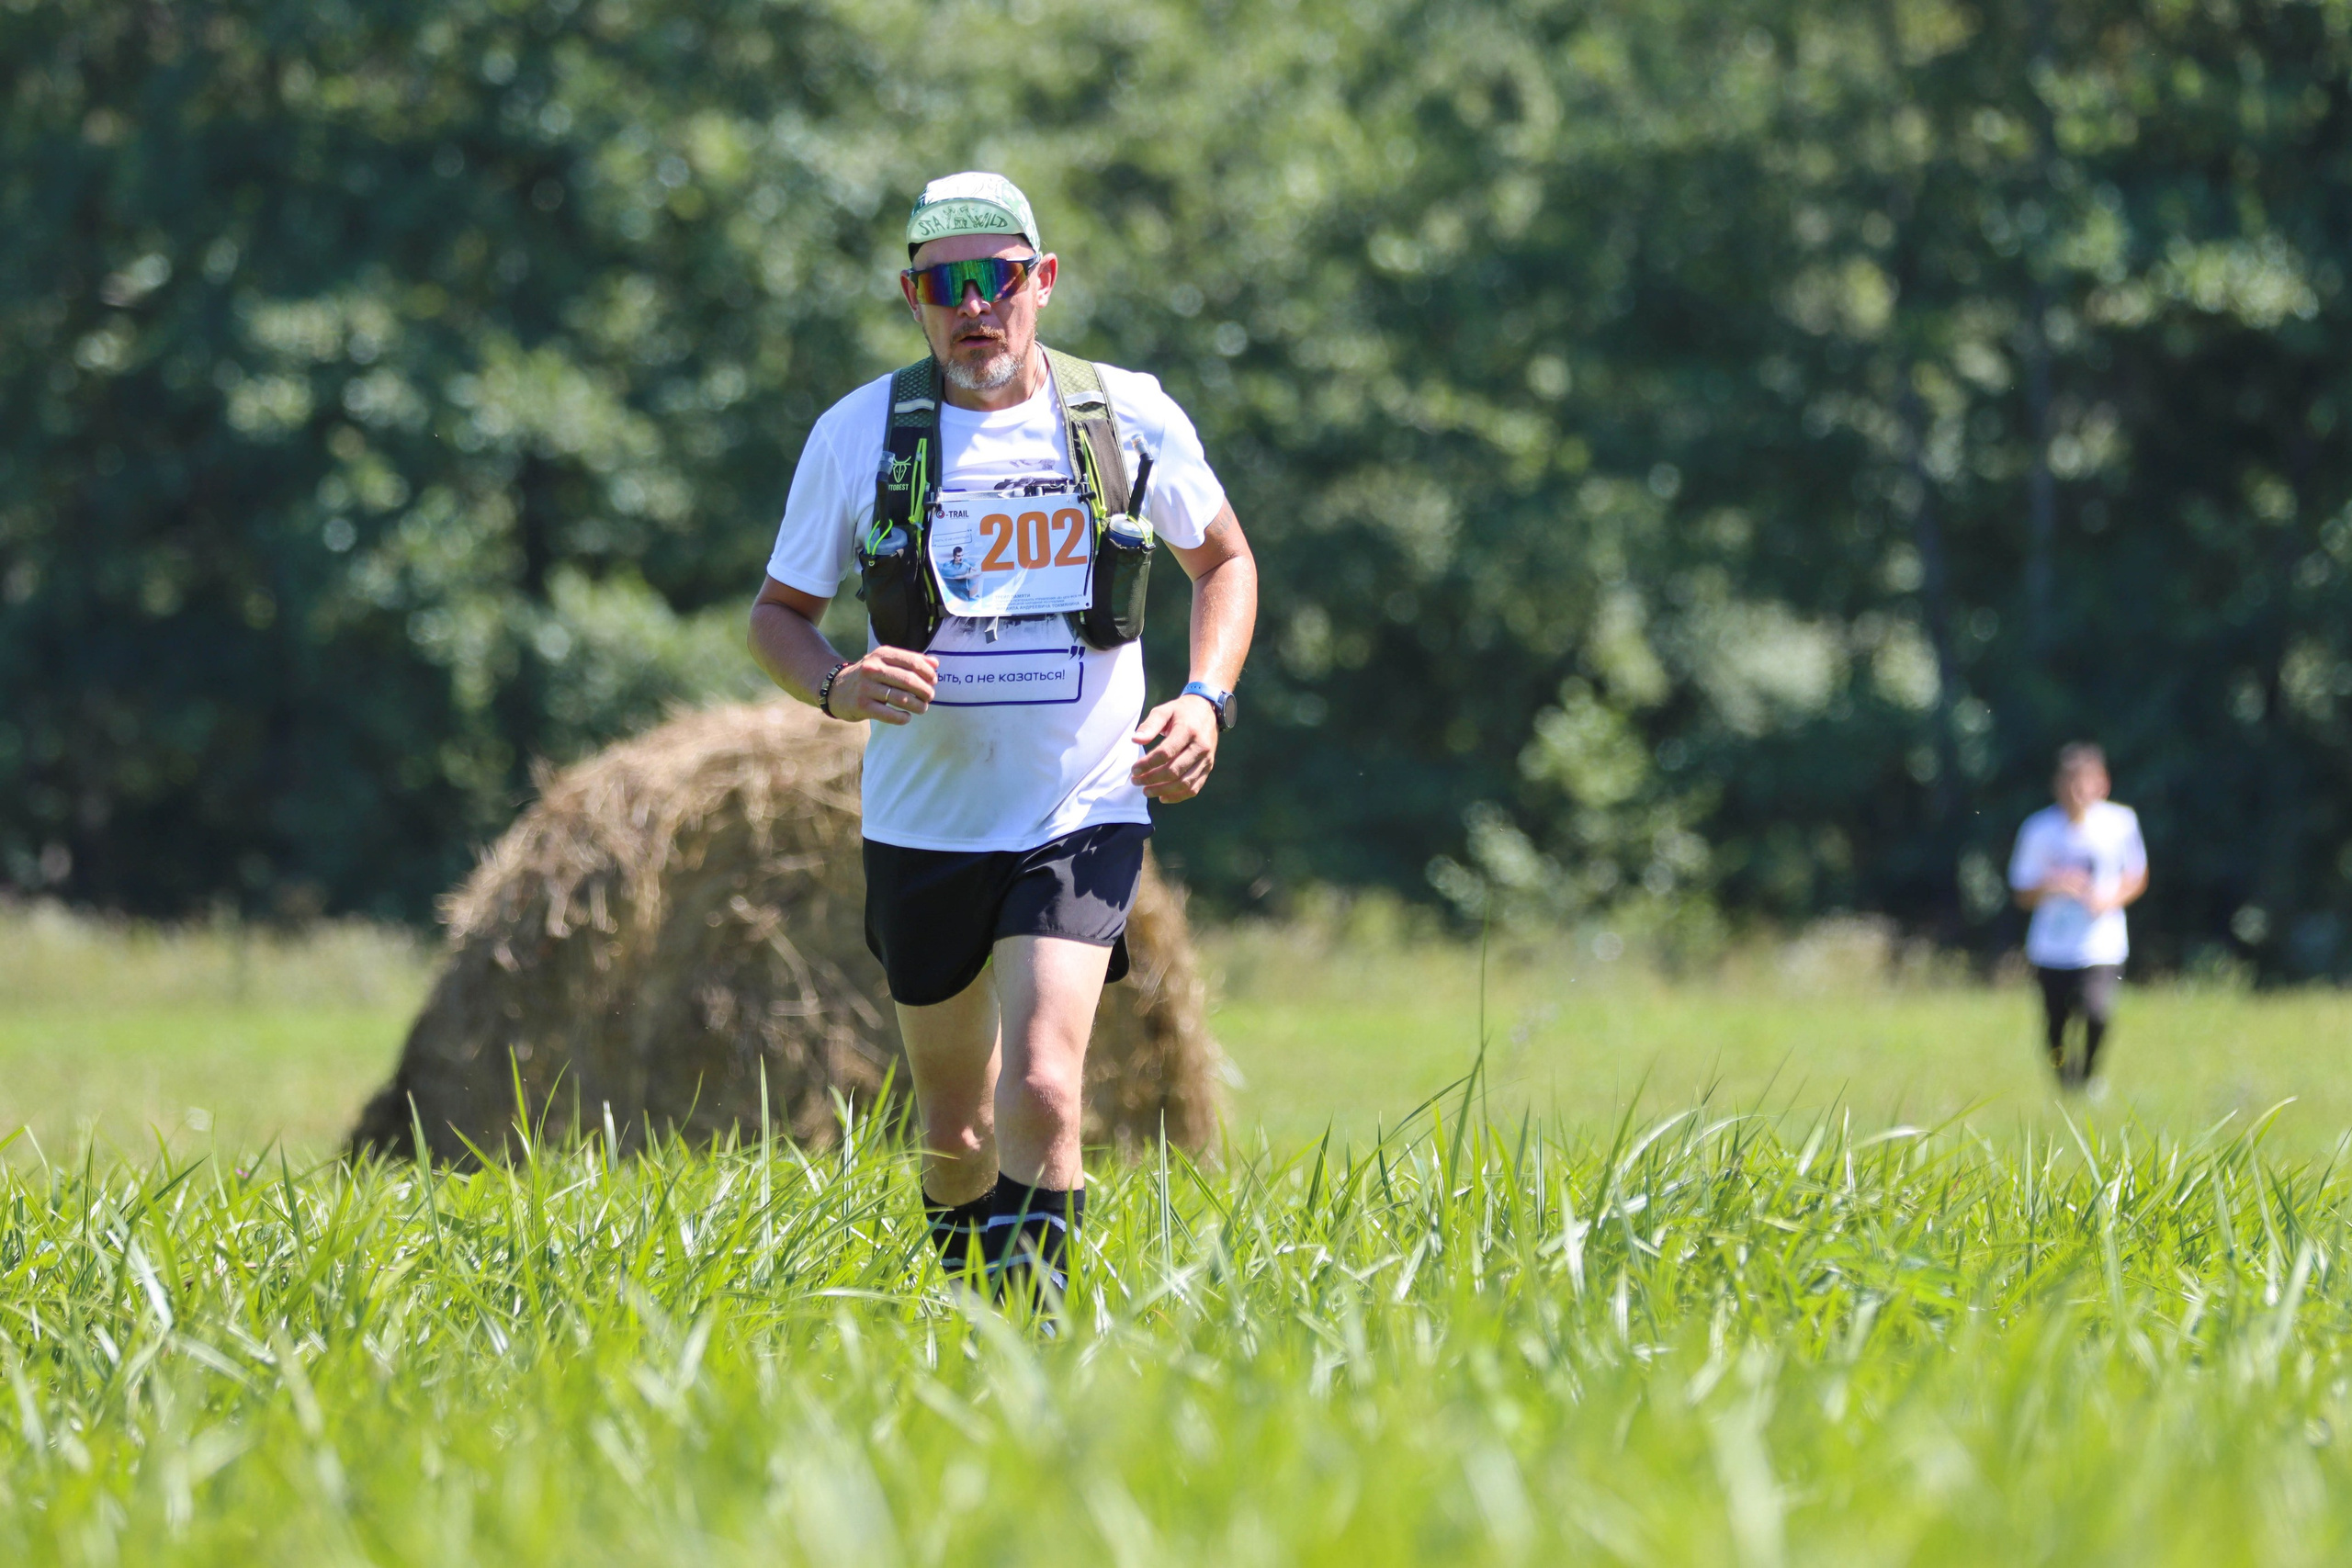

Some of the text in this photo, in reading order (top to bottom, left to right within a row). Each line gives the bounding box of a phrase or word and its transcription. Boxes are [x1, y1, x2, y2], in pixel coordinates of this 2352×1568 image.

[919, 206, 1008, 236] STAY WILD
[979, 507, 1088, 572] 202
[935, 670, 1065, 685] ыть, а не казаться!
